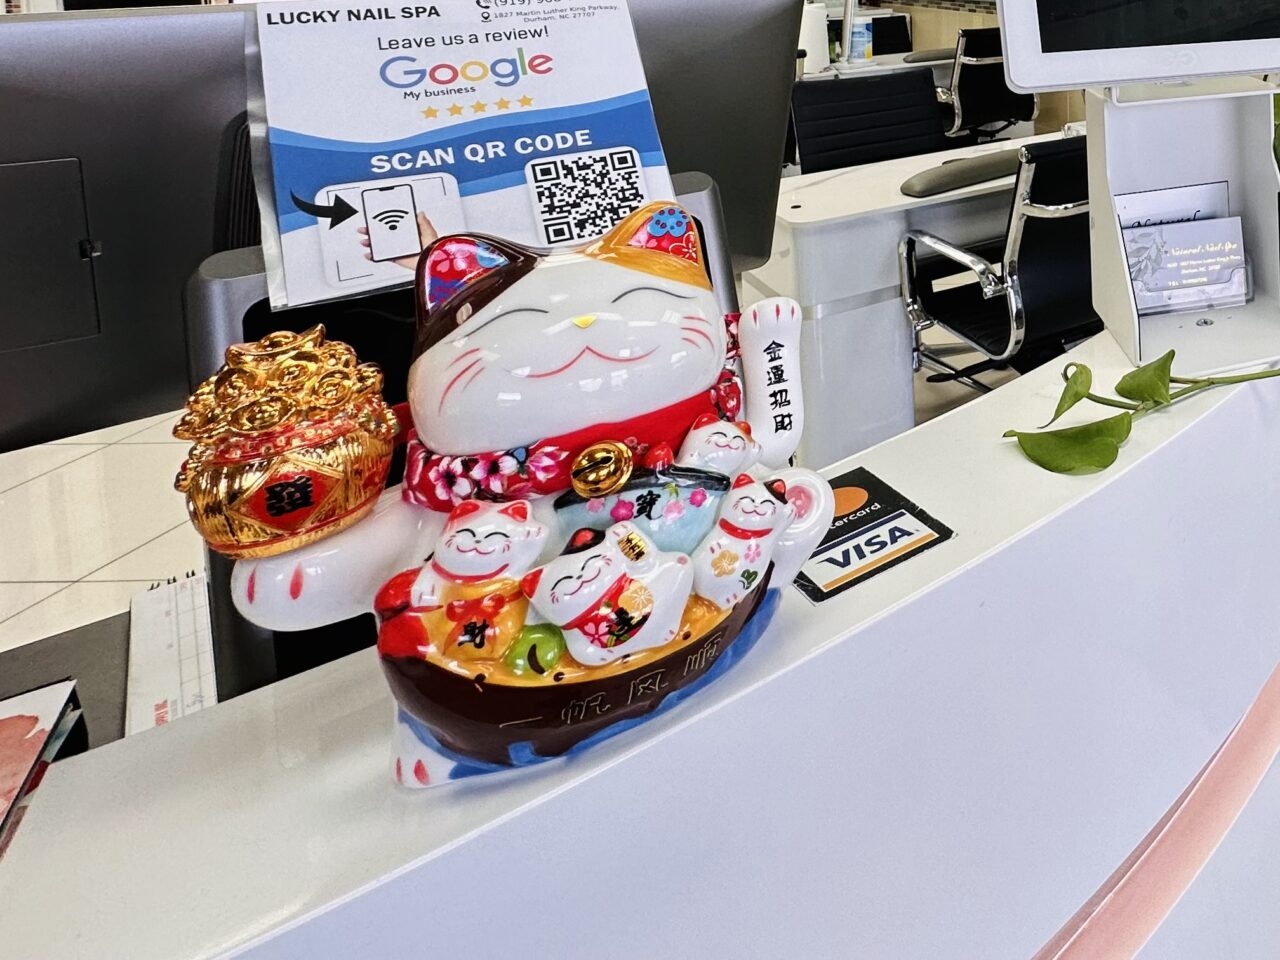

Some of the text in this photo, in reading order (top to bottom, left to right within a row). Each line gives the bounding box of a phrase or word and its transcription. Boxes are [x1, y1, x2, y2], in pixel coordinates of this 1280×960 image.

[266, 6, 440, 25] LUCKY NAIL SPA
[543, 7, 567, 15] Luther
[569, 5, 586, 13] King
[377, 25, 550, 51] Leave us a review!
[379, 47, 553, 88] Google
[403, 85, 477, 101] My business
[370, 129, 593, 173] SCAN QR CODE
[763, 340, 793, 434] 金運招財
[816, 526, 915, 568] VISA
